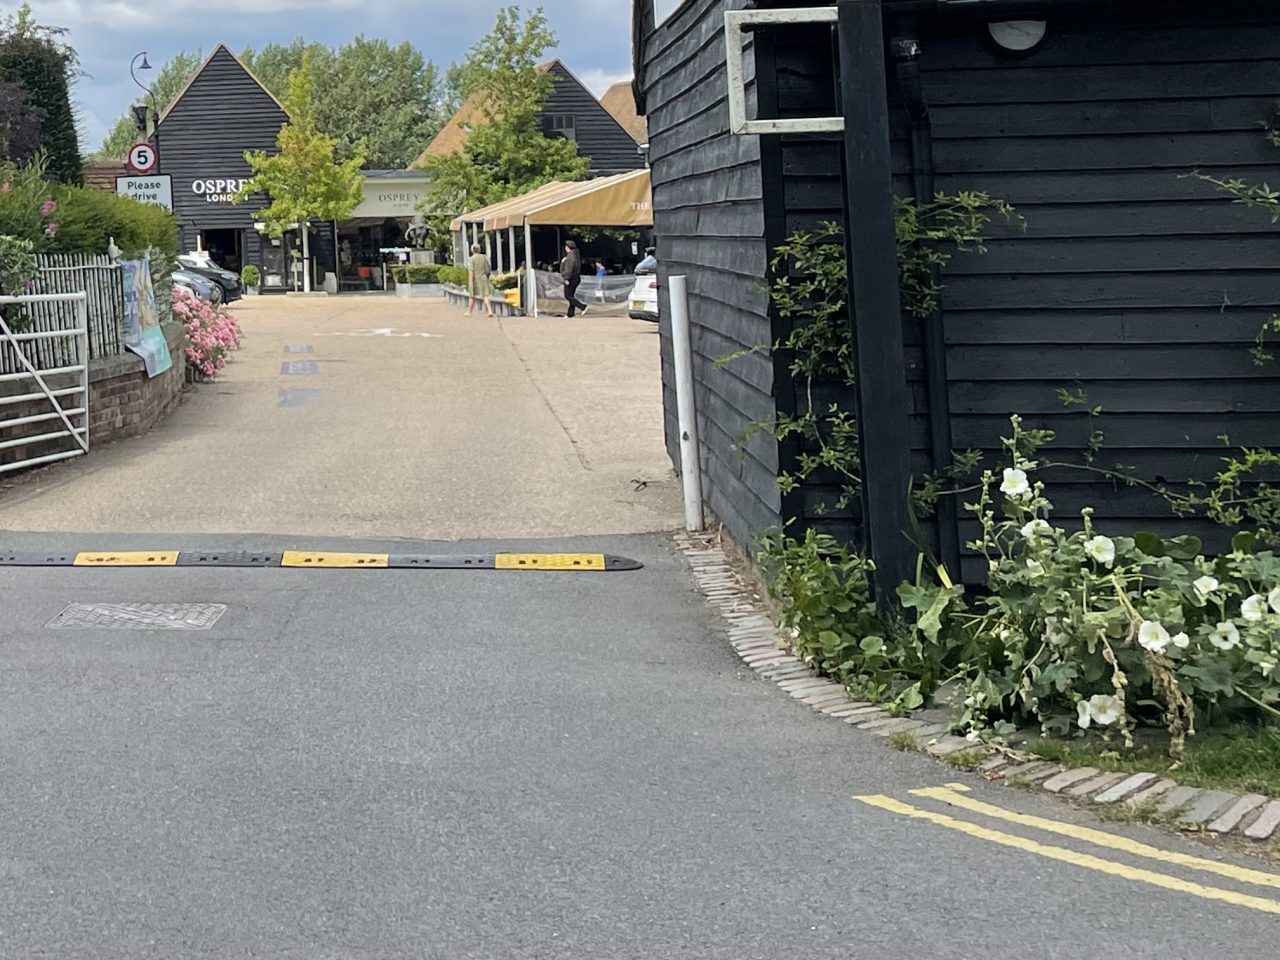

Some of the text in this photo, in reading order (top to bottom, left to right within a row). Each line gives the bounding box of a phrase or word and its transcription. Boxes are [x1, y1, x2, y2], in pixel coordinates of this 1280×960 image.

[137, 150, 148, 165] 5
[127, 181, 162, 190] Please
[131, 192, 158, 201] drive
[206, 194, 248, 202] LONDN
[378, 193, 419, 202] OSPREY
